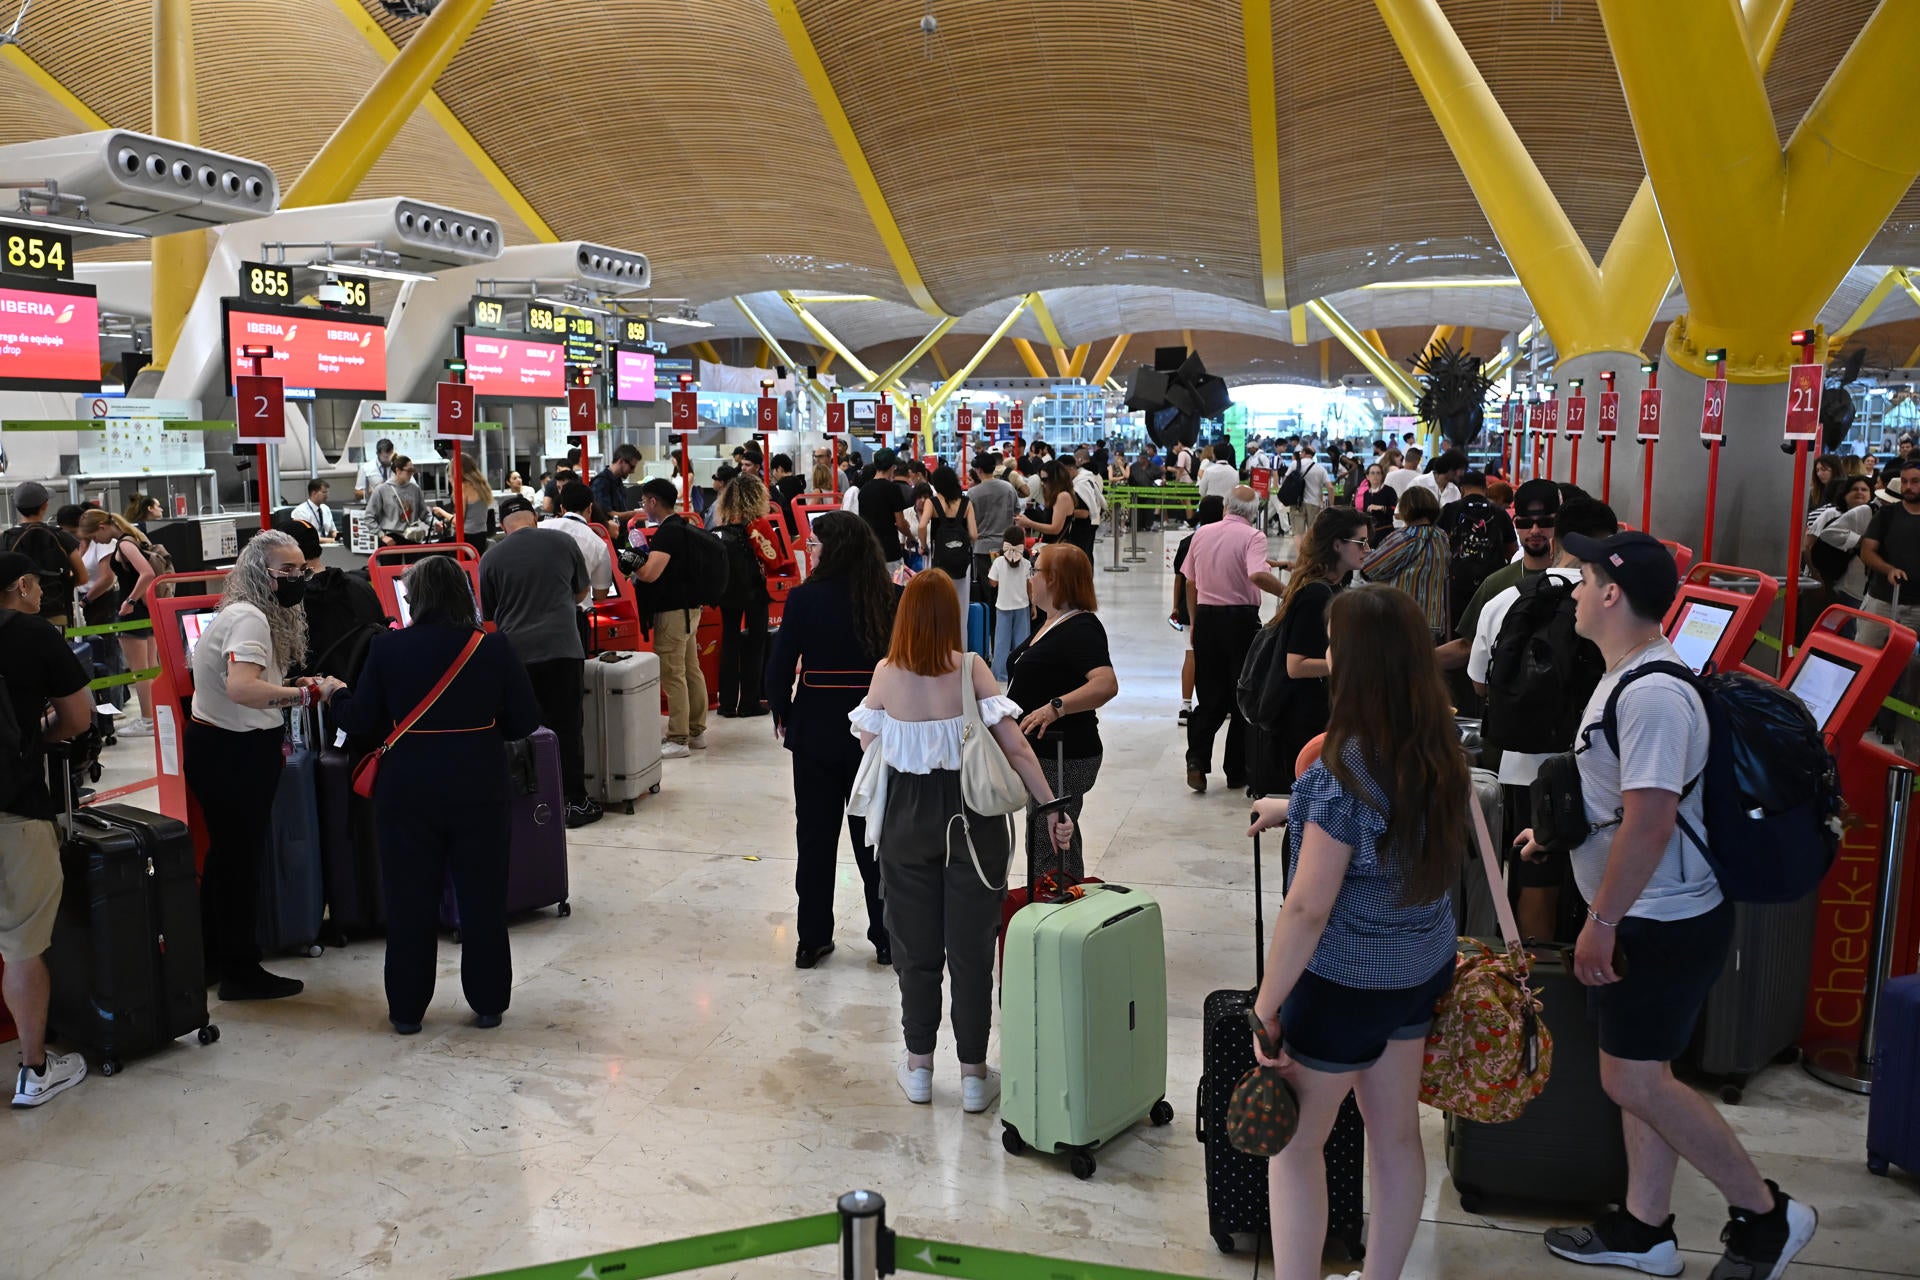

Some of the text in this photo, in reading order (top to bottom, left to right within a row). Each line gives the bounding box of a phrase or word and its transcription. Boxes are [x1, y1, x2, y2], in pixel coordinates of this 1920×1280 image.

[8, 236, 65, 271] 854
[251, 268, 289, 297] 855
[337, 280, 366, 306] 56
[0, 299, 55, 316] IBERIA
[478, 301, 503, 324] 857
[530, 308, 553, 330] 858
[247, 322, 284, 335] IBERIA
[627, 321, 645, 341] 859
[0, 333, 18, 344] rega
[30, 335, 64, 347] equipaje
[327, 330, 360, 342] IBERIA
[3, 345, 21, 356] drop
[254, 396, 269, 417] 2
[1706, 397, 1722, 417] 20
[1792, 388, 1814, 412] 21
[451, 401, 462, 419] 3
[577, 403, 588, 418] 4
[680, 404, 689, 418] 5
[764, 408, 772, 421] 6
[1532, 409, 1542, 420] 15
[1546, 409, 1557, 421] 16
[1569, 407, 1583, 420] 17
[1601, 405, 1615, 420] 18
[1642, 404, 1657, 421] 19
[833, 413, 840, 424] 7
[881, 413, 888, 424] 8
[913, 415, 919, 425] 9
[959, 415, 971, 425] 10
[987, 415, 997, 424] 11
[1012, 415, 1022, 424] 12
[1814, 822, 1879, 1028] Check-in
